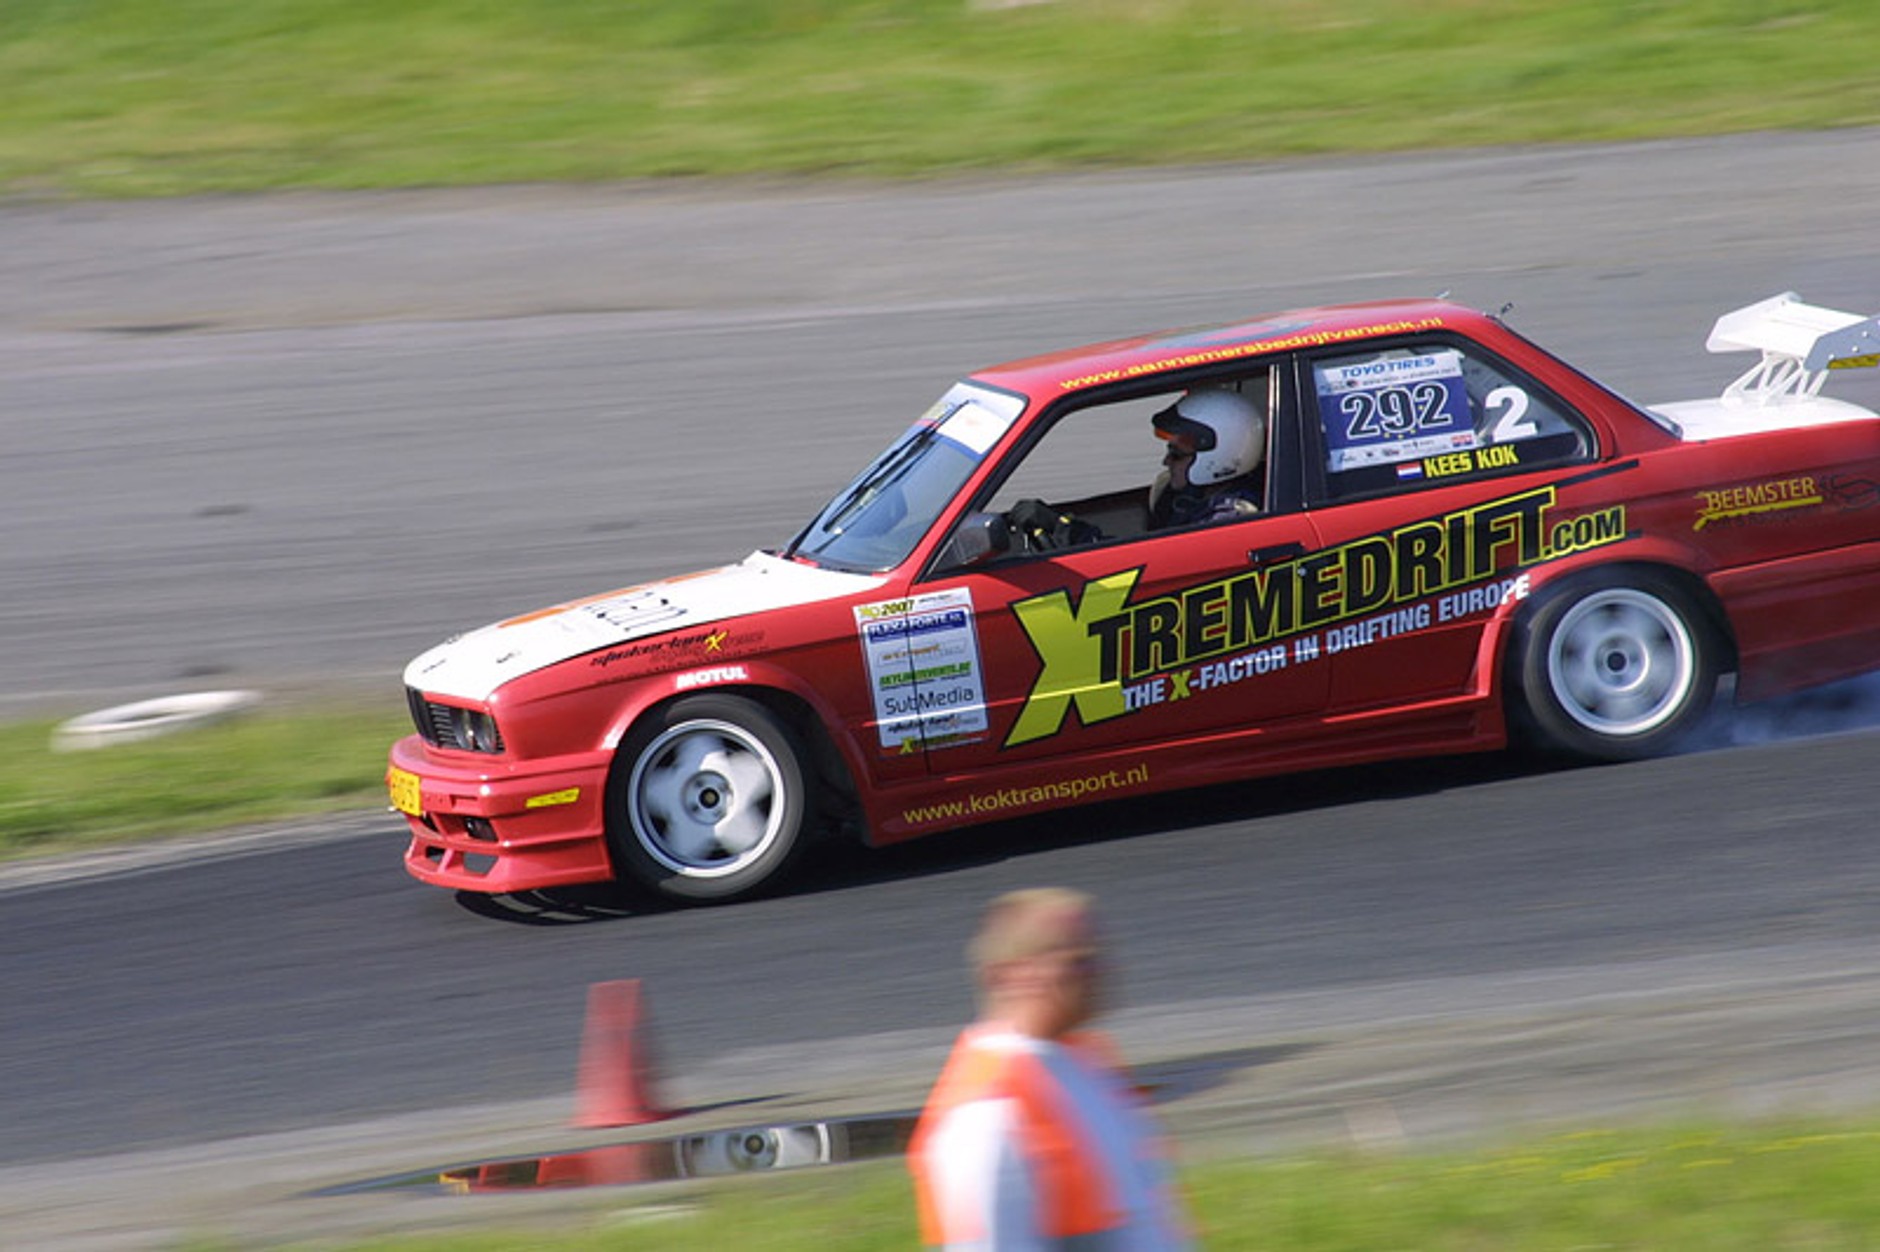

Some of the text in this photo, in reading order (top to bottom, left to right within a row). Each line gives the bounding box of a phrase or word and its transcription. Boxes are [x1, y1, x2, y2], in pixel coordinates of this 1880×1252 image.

[1341, 357, 1436, 379] TOYO TIRES
[1340, 381, 1453, 440] 292
[1485, 385, 1538, 443] 2
[1424, 453, 1473, 478] KEES
[1476, 445, 1519, 469] KOK
[1704, 476, 1816, 511] BEEMSTER
[1122, 573, 1532, 711] THE X-FACTOR IN DRIFTING EUROPE
[676, 665, 748, 689] MOTUL
[884, 686, 975, 715] SubMedia
[903, 763, 1149, 824] www.koktransport.nl
